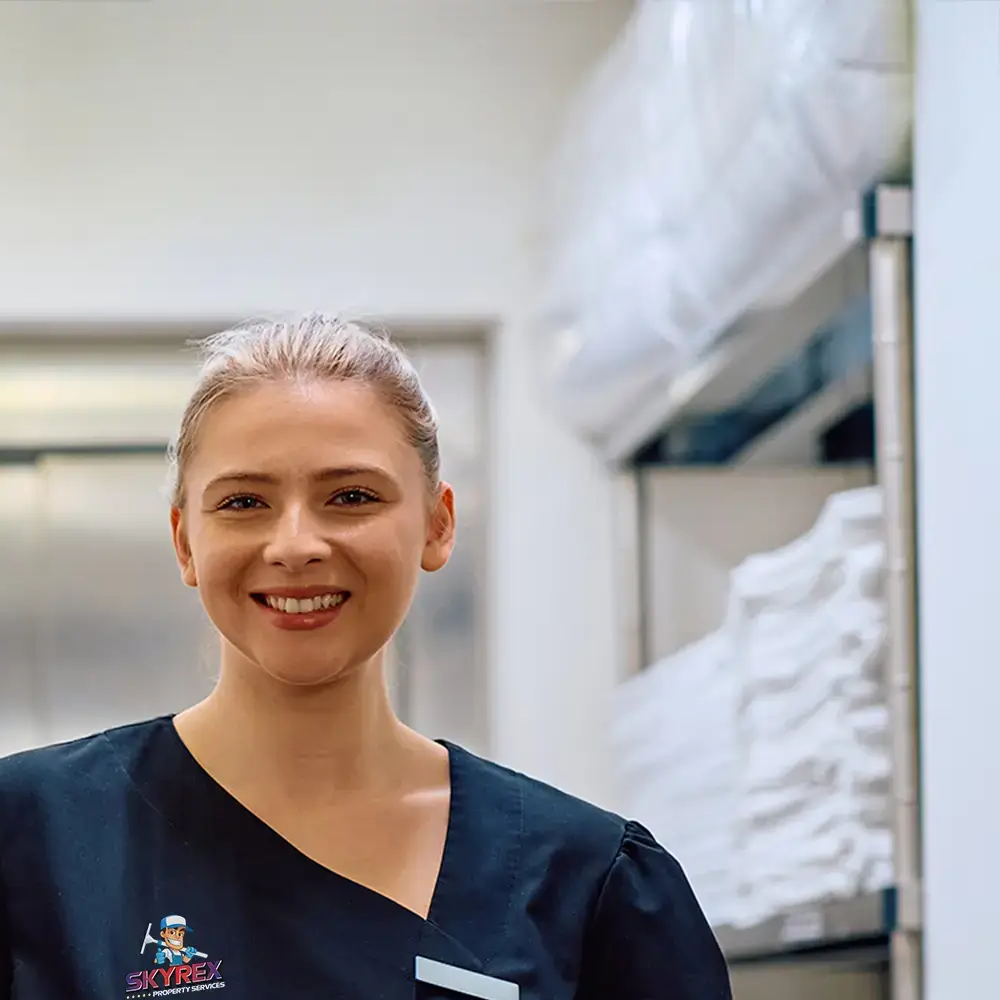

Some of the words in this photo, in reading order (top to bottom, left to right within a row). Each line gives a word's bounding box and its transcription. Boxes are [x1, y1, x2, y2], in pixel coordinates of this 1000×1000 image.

[125, 960, 222, 992] SKYREX
[152, 985, 191, 997] PROPERTY
[191, 981, 226, 992] SERVICES
